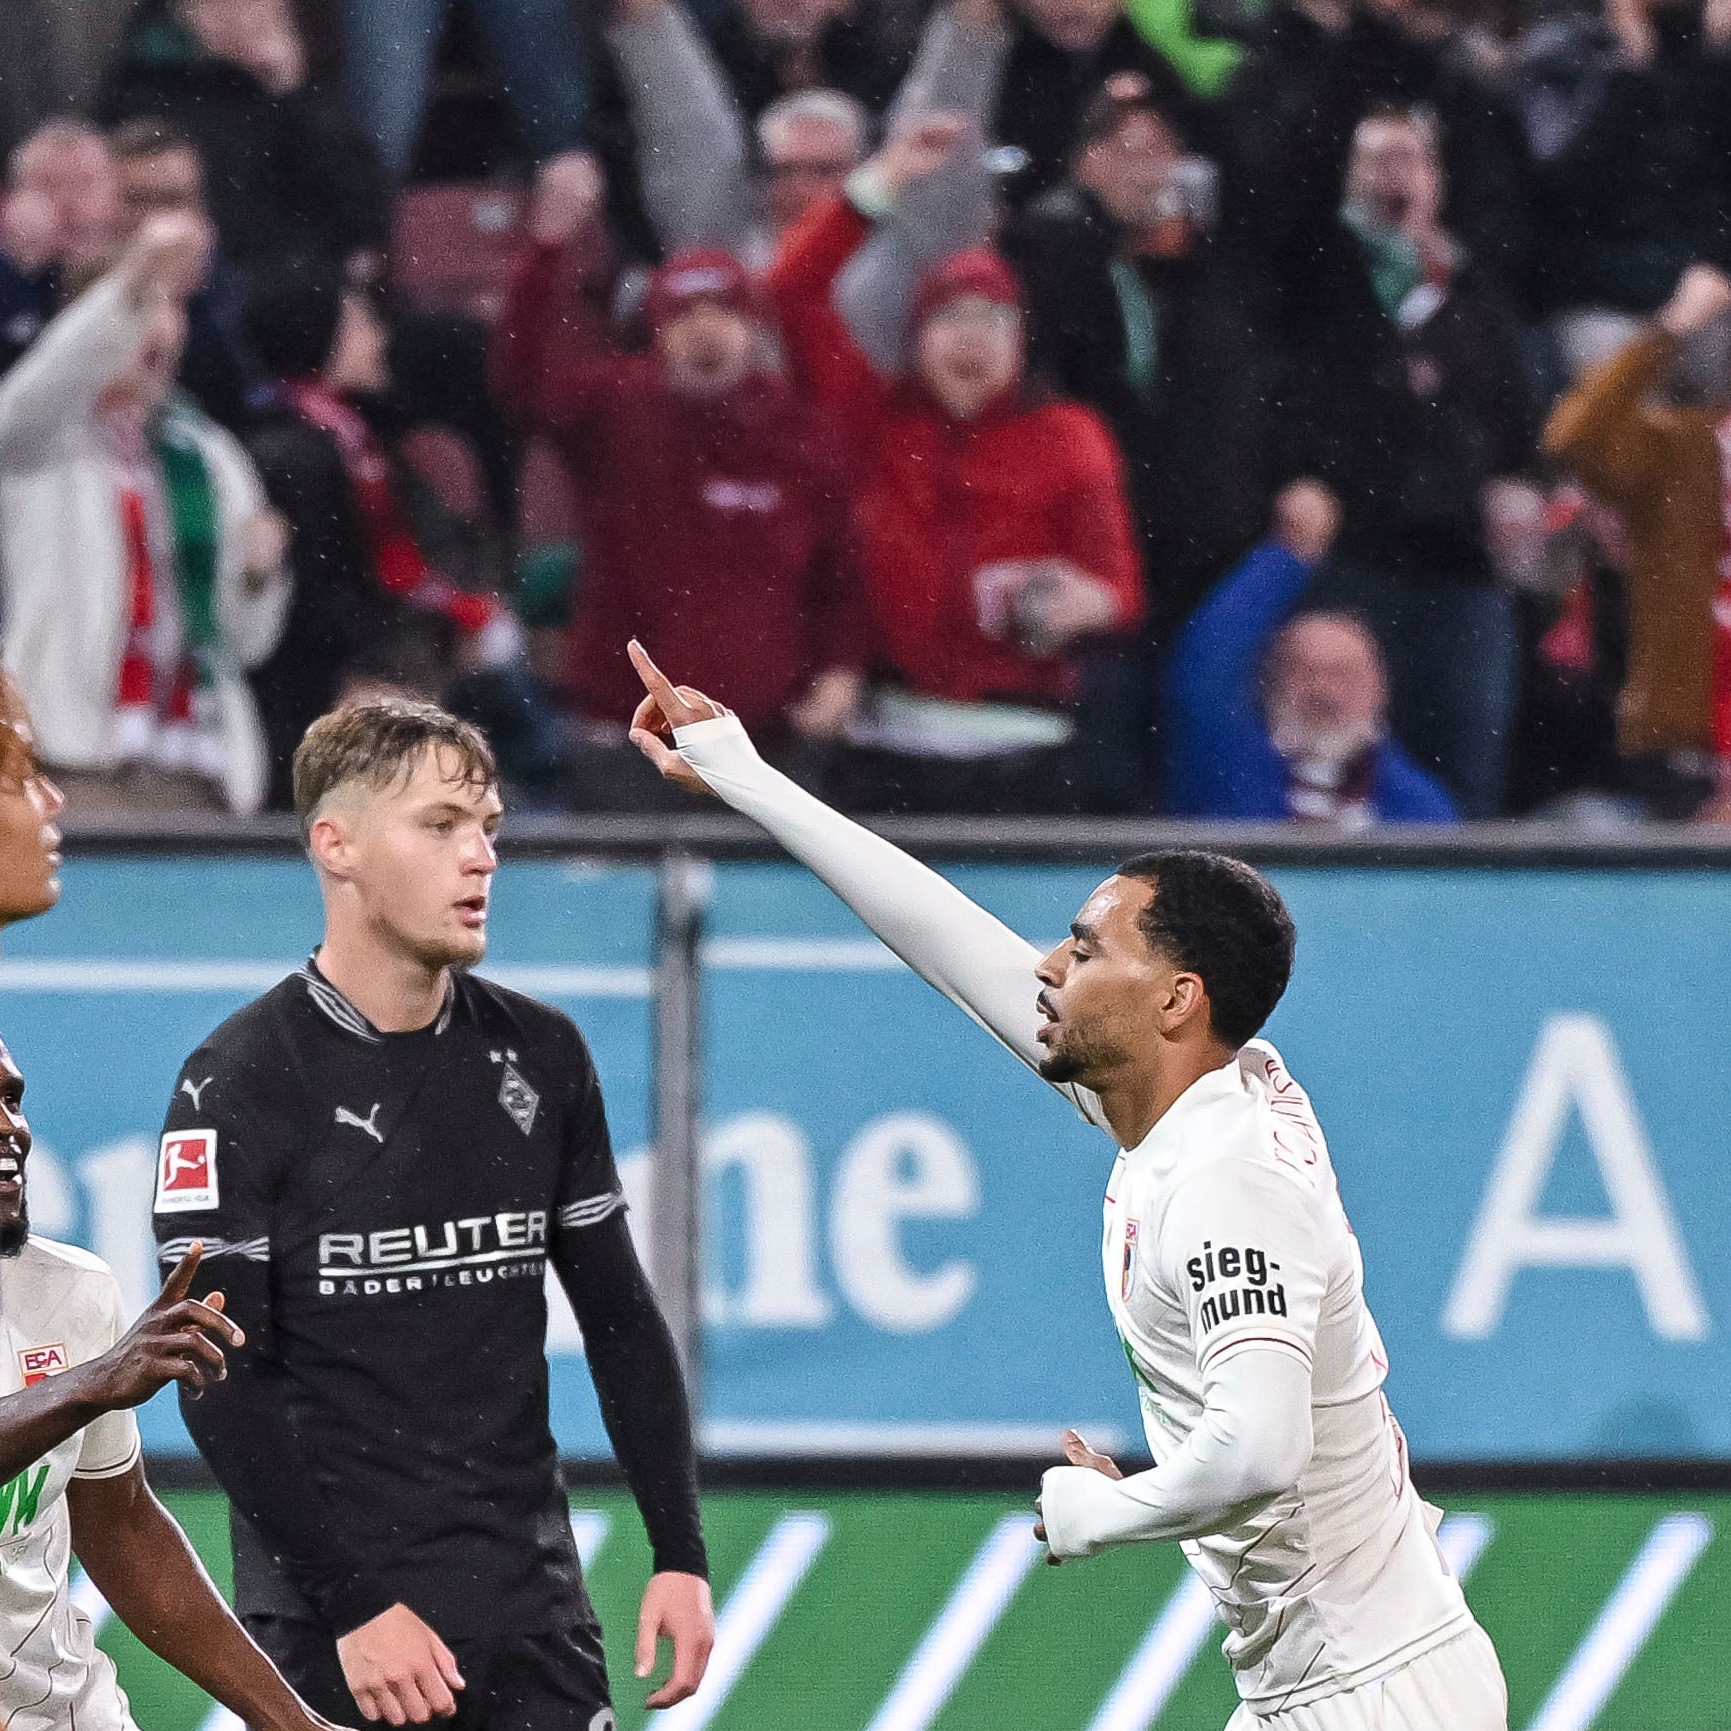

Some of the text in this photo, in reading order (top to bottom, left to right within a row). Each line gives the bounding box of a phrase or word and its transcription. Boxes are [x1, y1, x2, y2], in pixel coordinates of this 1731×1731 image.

[319, 1211, 547, 1264] REUTER
[1186, 1240, 1280, 1293] sieg-
[1200, 1283, 1288, 1334] mund
